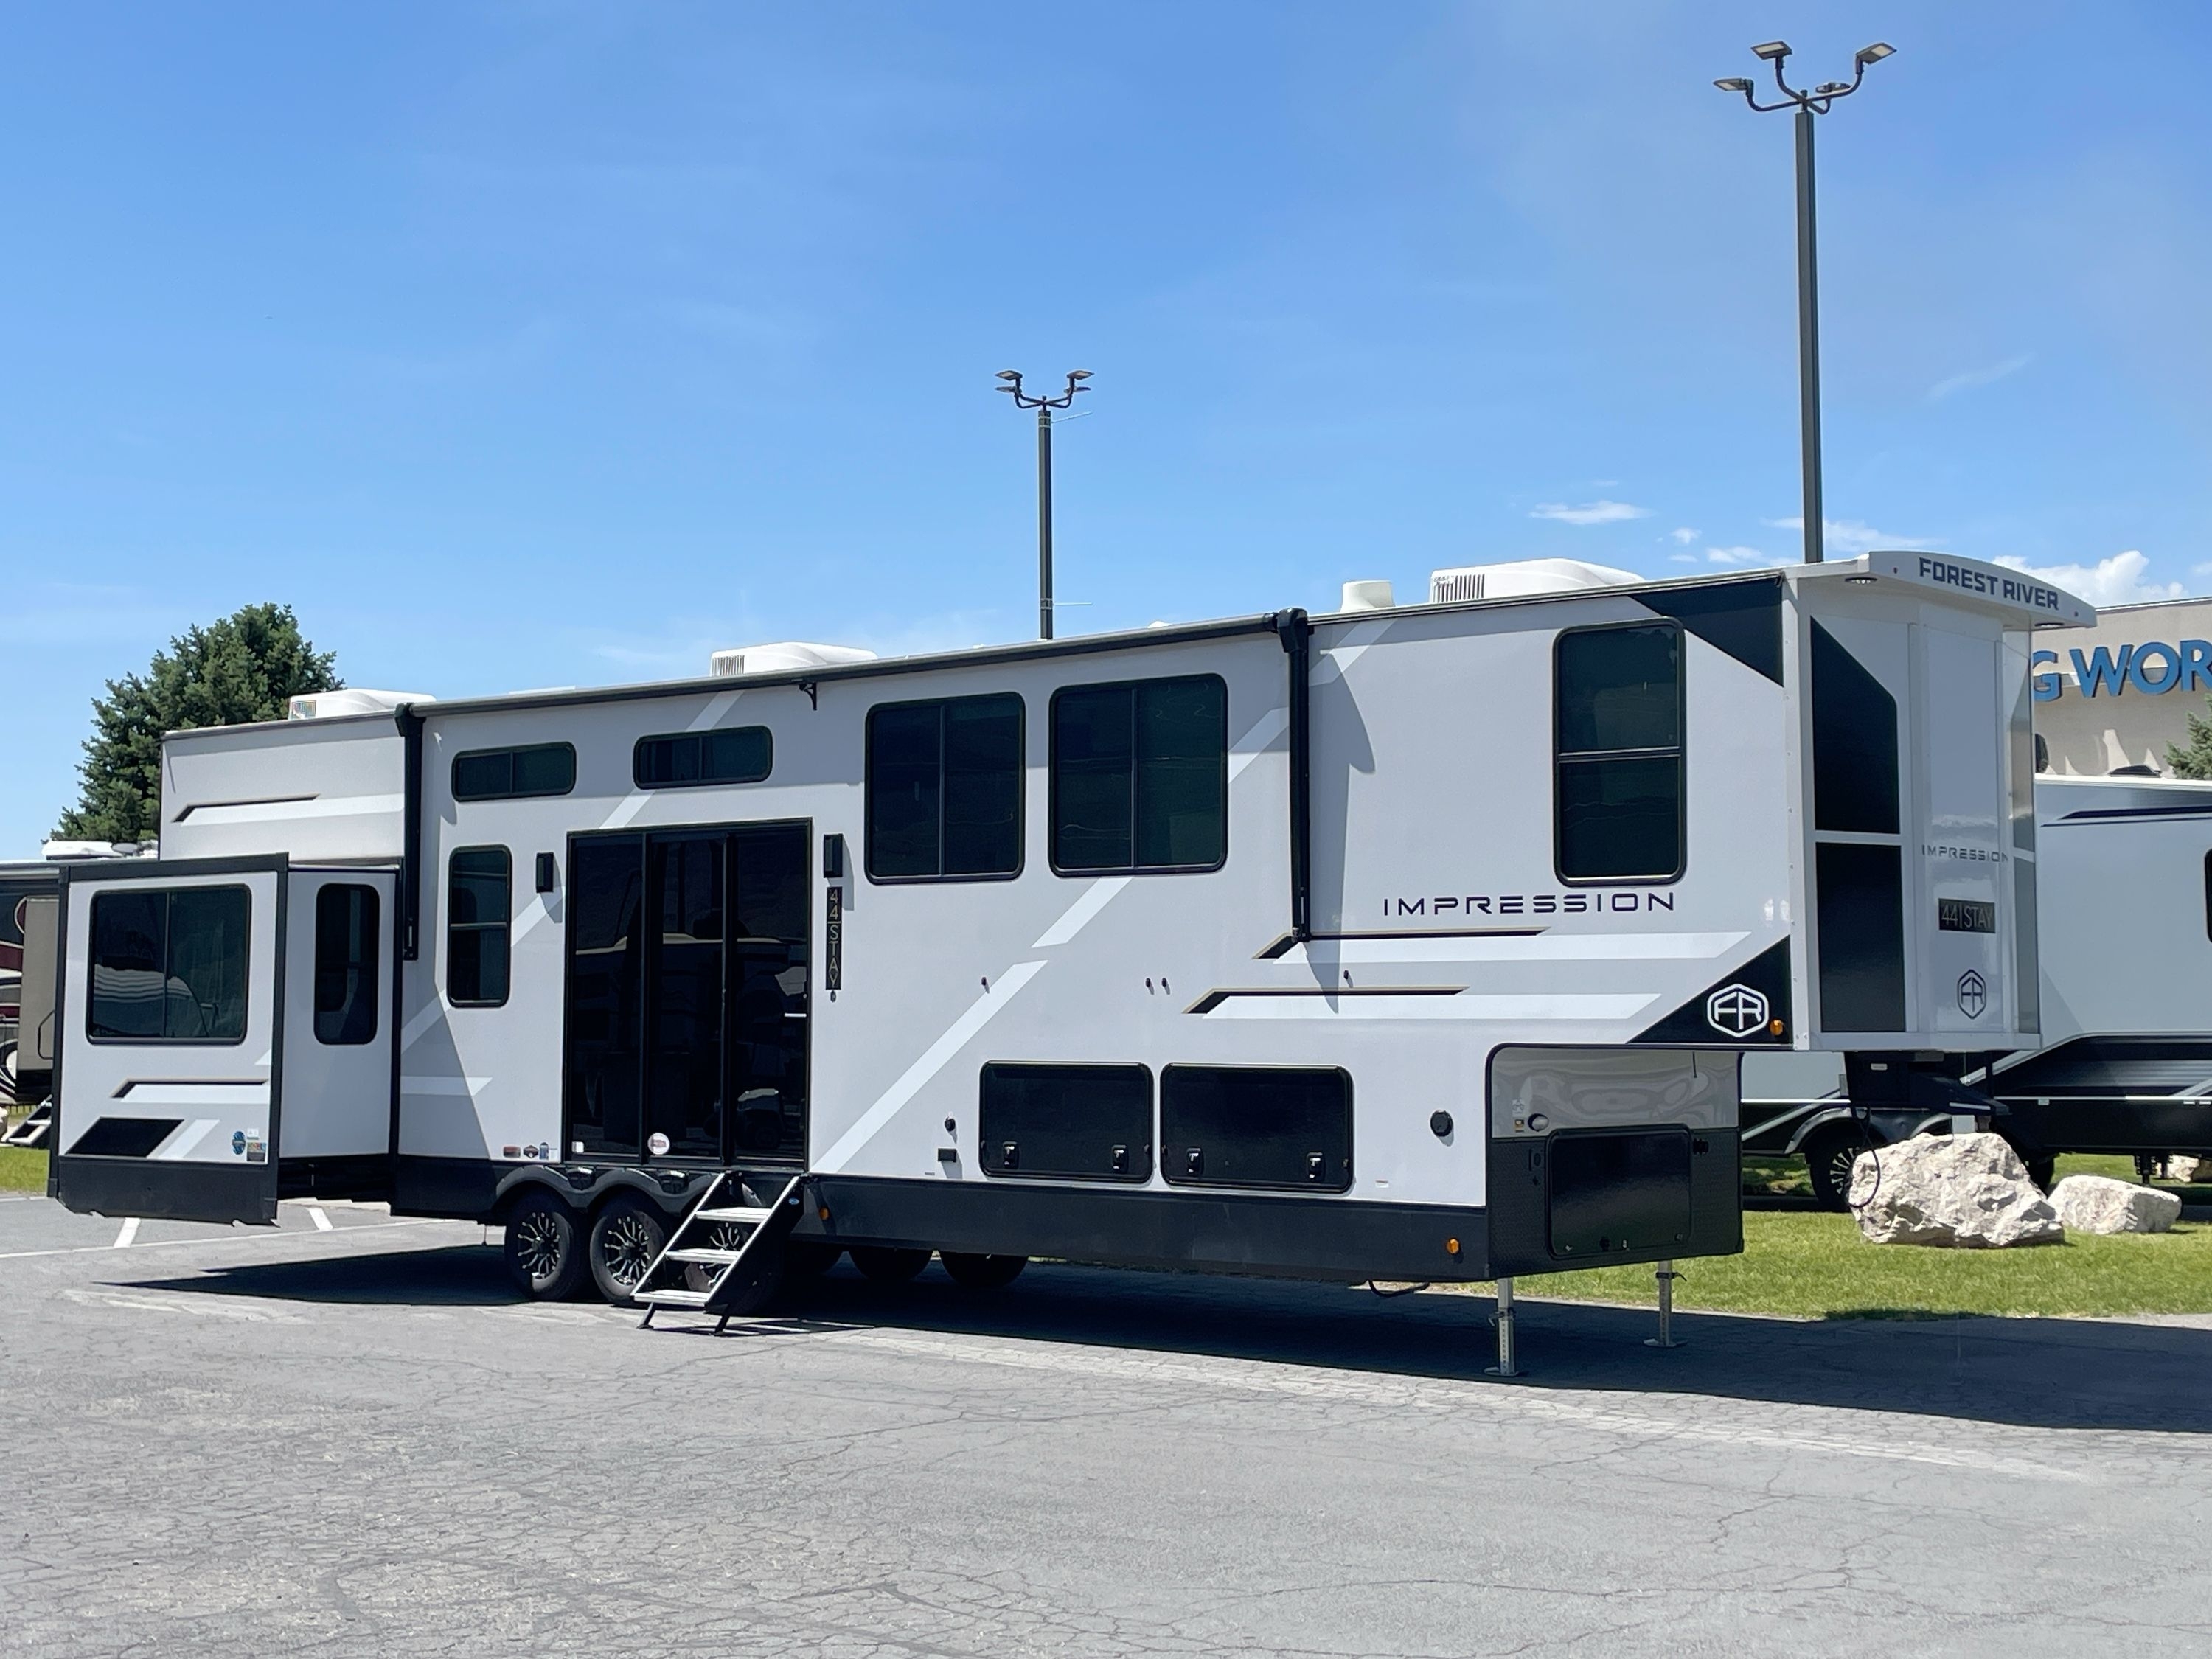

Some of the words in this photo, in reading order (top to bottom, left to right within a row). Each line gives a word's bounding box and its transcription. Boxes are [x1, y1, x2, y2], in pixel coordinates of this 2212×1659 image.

[1919, 557, 1998, 595] FOREST
[2003, 579, 2059, 611] RIVER
[1921, 844, 2008, 863] IMPRESSION
[1384, 892, 1674, 916] IMPRESSION
